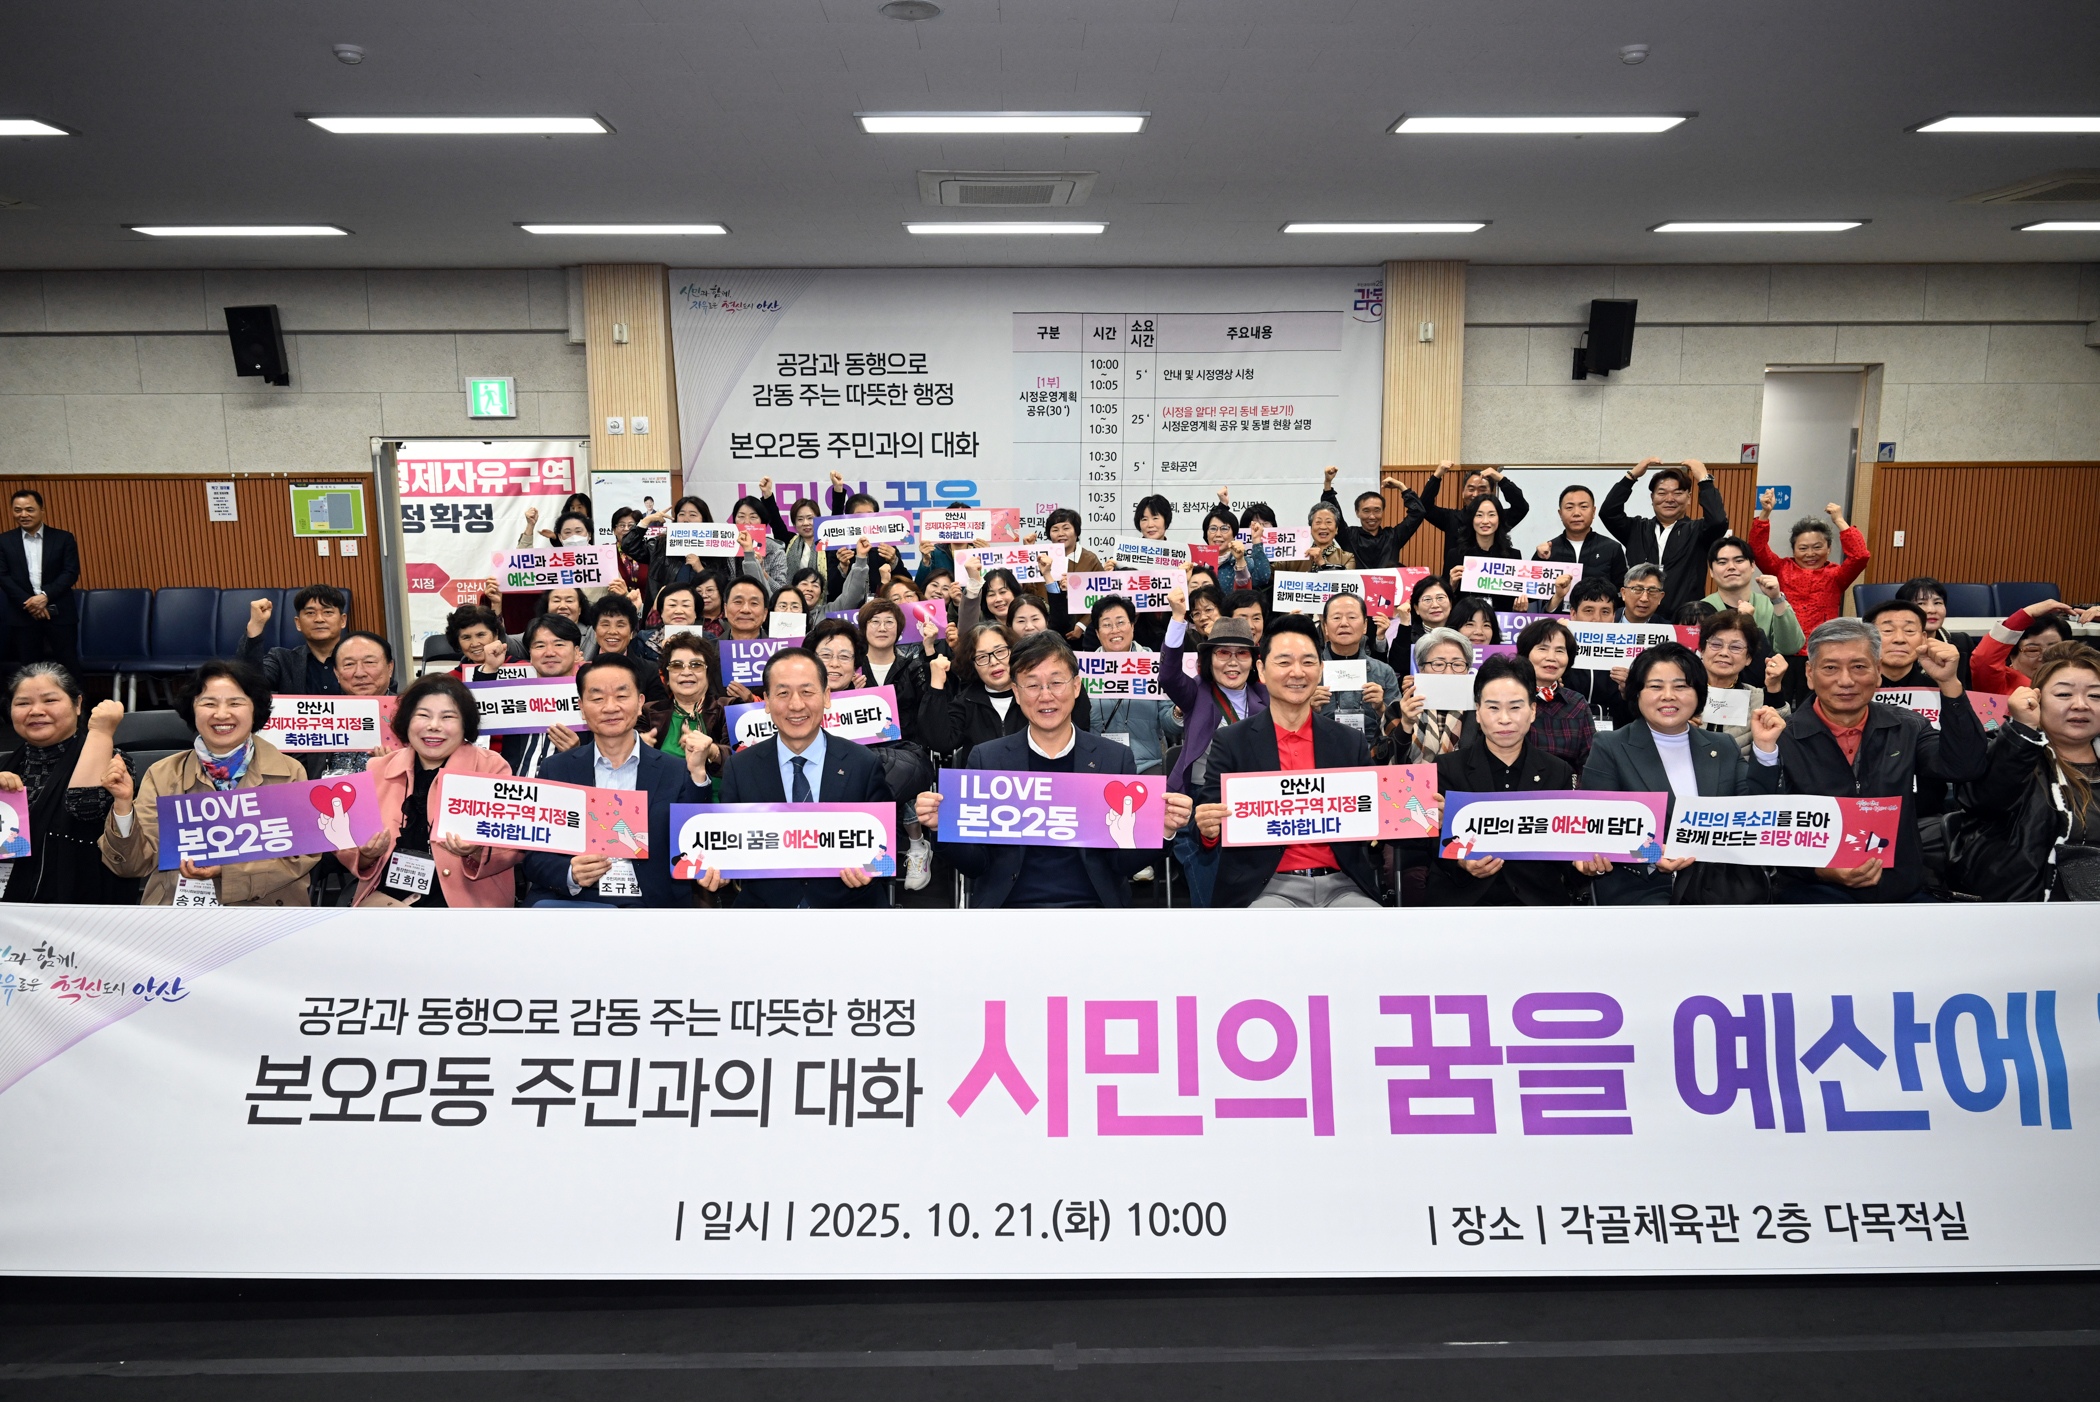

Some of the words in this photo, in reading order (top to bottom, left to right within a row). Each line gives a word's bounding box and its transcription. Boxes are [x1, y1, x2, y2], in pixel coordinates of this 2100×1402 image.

[757, 301, 781, 312] 안산
[1037, 326, 1060, 340] 구분
[1093, 327, 1117, 340] 시간
[1131, 320, 1154, 332] 소요
[1226, 325, 1273, 340] 주요내용
[1130, 334, 1154, 348] 시간
[776, 353, 840, 377] 공감과
[844, 353, 928, 375] 동행으로
[1090, 359, 1119, 369] 10:00
[1037, 377, 1060, 388] [1부]
[1163, 369, 1182, 381] 안내
[1184, 369, 1194, 381] 및
[1196, 369, 1233, 381] 시정영상
[1235, 368, 1254, 380] 시청
[1090, 380, 1118, 390] 10:05
[752, 383, 794, 407] 감동
[798, 383, 841, 407] 주는
[846, 383, 908, 407] 따뜻한
[913, 383, 954, 406] 행정
[1020, 391, 1077, 402] 시정운영계획
[1090, 404, 1118, 414] 10:05
[1162, 406, 1193, 418] (시정을
[1219, 406, 1237, 417] 우리
[1240, 405, 1258, 417] 동네
[1260, 405, 1294, 416] 돋보기!)
[1089, 424, 1118, 434] 10:30
[1162, 420, 1217, 432] 시정운영계획
[1219, 420, 1238, 431] 공유
[1240, 420, 1249, 431] 및
[1252, 419, 1270, 431] 동별
[1272, 419, 1291, 430] 현황
[1293, 419, 1312, 430] 설명
[730, 432, 821, 459] 본오2동
[827, 432, 924, 459] 주민과의
[931, 432, 979, 459] 대화
[1089, 452, 1117, 461] 10:30
[1161, 461, 1197, 472] 문화공연
[1088, 472, 1116, 481] 10:35
[1088, 493, 1116, 503] 10:35
[430, 504, 495, 533] 확정
[945, 512, 966, 521] 안산시
[1088, 512, 1116, 522] 10:40
[670, 529, 691, 539] 시민의
[691, 529, 719, 539] 목소리를
[720, 530, 735, 539] 담아
[823, 527, 845, 537] 시민의
[888, 523, 905, 533] 담다
[938, 531, 974, 540] 축하합니다
[669, 539, 682, 548] 함께
[684, 539, 704, 548] 만드는
[705, 539, 719, 548] 희망
[720, 539, 735, 549] 예산
[1088, 537, 1116, 546] 10:40
[1116, 552, 1130, 563] 함께
[1132, 554, 1154, 565] 만드는
[1155, 557, 1170, 566] 희망
[1117, 543, 1139, 554] 시민의
[1140, 545, 1169, 556] 목소리를
[1171, 549, 1186, 559] 담아
[509, 554, 546, 569] 시민과
[549, 552, 599, 568] 소통하고
[507, 571, 559, 587] 예산으로
[560, 569, 601, 585] 답하다
[1481, 562, 1516, 577] 시민과
[1518, 564, 1564, 580] 소통하고
[412, 578, 435, 590] 지정
[1086, 577, 1123, 592] 시민과
[1127, 575, 1172, 591] 소통하고
[1278, 580, 1303, 591] 시민의
[1305, 582, 1339, 593] 목소리를
[1341, 583, 1358, 593] 담아
[1477, 576, 1524, 593] 예산으로
[1277, 591, 1294, 602] 함께
[1295, 592, 1321, 603] 만드는
[1574, 632, 1604, 645] 시민의
[1606, 633, 1646, 645] 목소리를
[1593, 646, 1624, 658] 만드는
[1078, 658, 1118, 675] 시민과
[297, 701, 335, 715] 안산시
[501, 699, 527, 714] 꿈을
[529, 697, 569, 713] 예산에
[855, 706, 882, 724] 담다
[336, 717, 375, 731] 지정을
[285, 733, 350, 746] 축하합니다
[493, 782, 538, 802] 안산시
[961, 775, 967, 798] I
[973, 776, 1053, 801] LOVE
[1280, 777, 1325, 796] 안산시
[175, 800, 183, 824] I
[184, 792, 261, 824] LOVE
[447, 797, 536, 823] 경제자유구역
[538, 808, 581, 829] 지정을
[1234, 797, 1324, 819] 경제자유구역
[1327, 794, 1372, 813] 지정을
[957, 804, 1079, 841] 본오2동
[1266, 817, 1342, 837] 축하합니다
[1465, 817, 1514, 836] 시민의
[1517, 816, 1549, 834] 꿈을
[1551, 815, 1604, 834] 예산에
[1607, 817, 1644, 836] 담다
[1680, 810, 1730, 829] 시민의
[1732, 809, 1793, 828] 목소리를
[1795, 811, 1830, 829] 담아
[177, 817, 293, 861] 본오2동
[475, 820, 552, 844] 축하합니다
[692, 830, 743, 850] 시민의
[746, 830, 780, 850] 꿈을
[783, 829, 835, 849] 예산에
[838, 829, 874, 849] 담다
[1675, 829, 1711, 846] 함께
[1713, 829, 1758, 847] 만드는
[1759, 829, 1792, 847] 희망
[1794, 830, 1830, 849] 예산
[50, 975, 125, 1005] 혁신도시
[132, 976, 191, 1002] 안산
[299, 998, 409, 1037] 공감과
[417, 998, 561, 1036] 동행으로
[569, 998, 641, 1036] 감동
[649, 999, 721, 1036] 주는
[730, 998, 837, 1037] 따뜻한
[847, 997, 917, 1037] 행정
[947, 995, 1336, 1138] 시민의
[1374, 991, 1636, 1136] 꿈을
[1673, 990, 2073, 1134] 예산에
[245, 1055, 494, 1126] 본오2동
[510, 1057, 774, 1128] 주민과의
[794, 1057, 923, 1128] 대화
[700, 1202, 770, 1241] 일시
[809, 1203, 912, 1241] 2025.
[928, 1203, 980, 1240] 10.
[1000, 1200, 1111, 1241] 21.(화)
[1126, 1201, 1227, 1239] 10:00
[1451, 1205, 1522, 1245] 장소
[1561, 1204, 1740, 1245] 각골체육관
[1753, 1203, 1811, 1243] 2층
[1823, 1199, 1969, 1243] 다목적실
